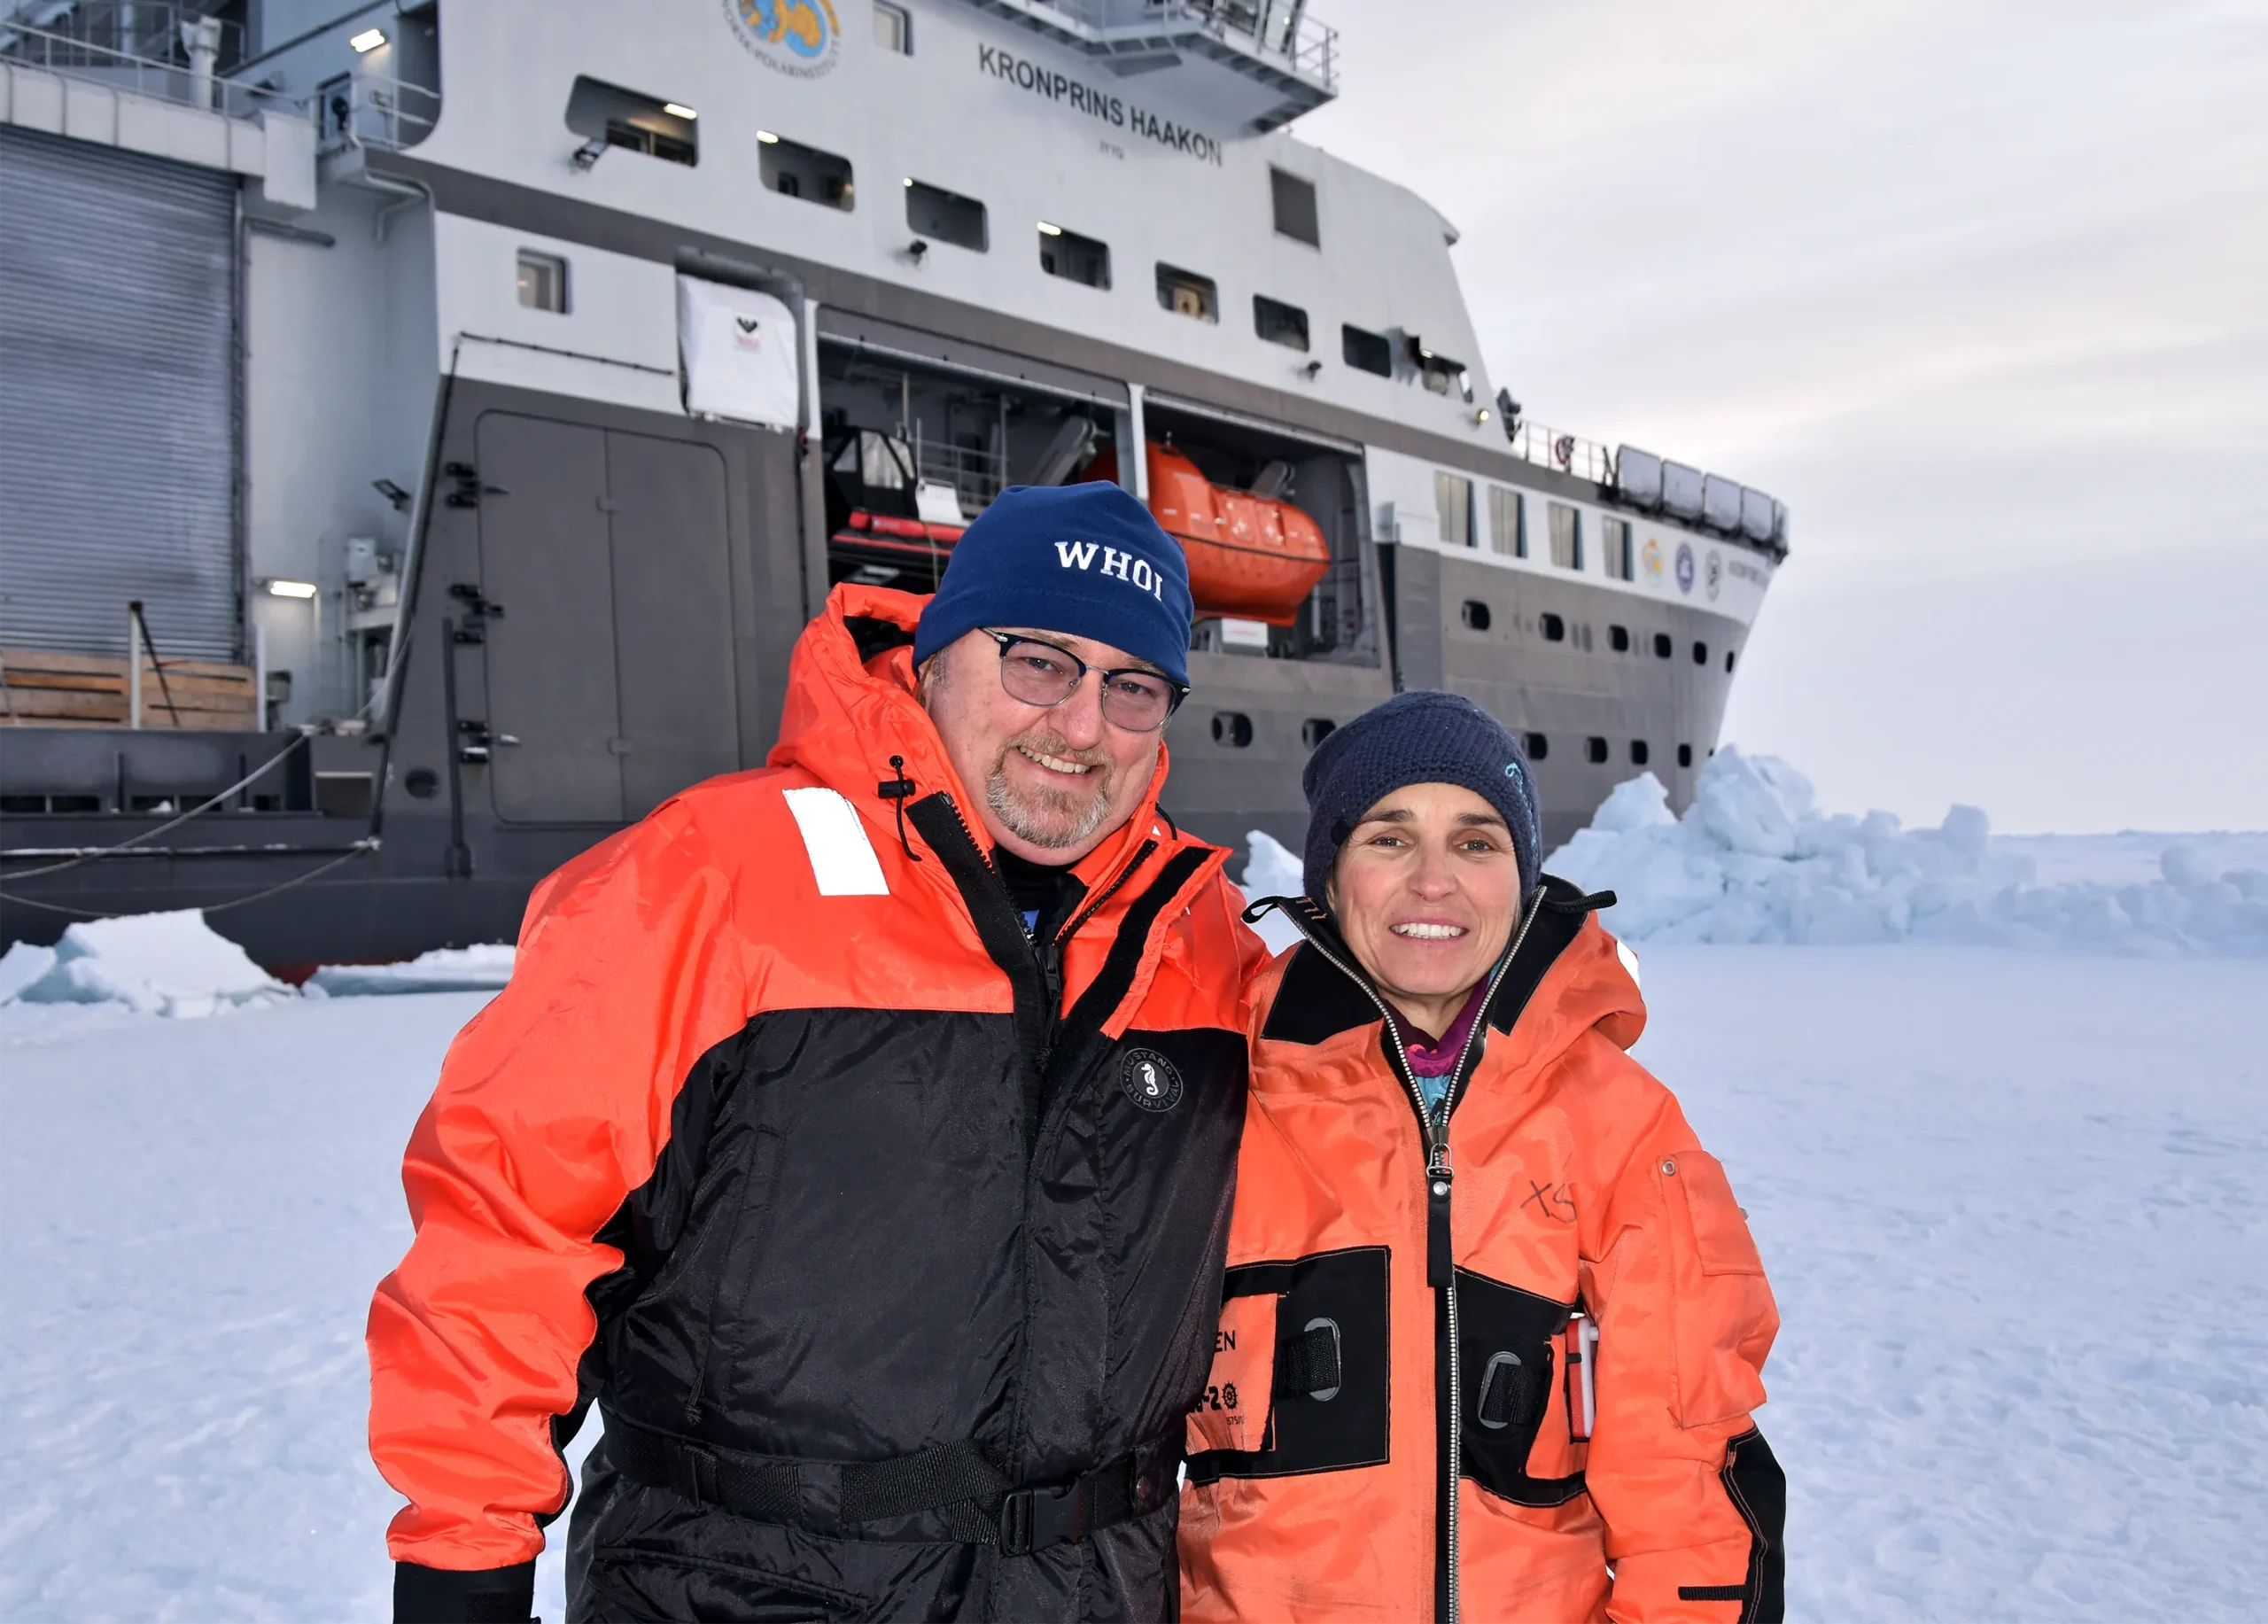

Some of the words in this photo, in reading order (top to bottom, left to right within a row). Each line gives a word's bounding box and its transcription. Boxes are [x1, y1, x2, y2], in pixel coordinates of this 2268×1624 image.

[979, 43, 1123, 127] KRONPRINS
[1130, 105, 1222, 167] HAAKON
[1053, 541, 1163, 602] WHOI
[1126, 1081, 1179, 1107] SURVIVAL
[1520, 1180, 1577, 1224] XS
